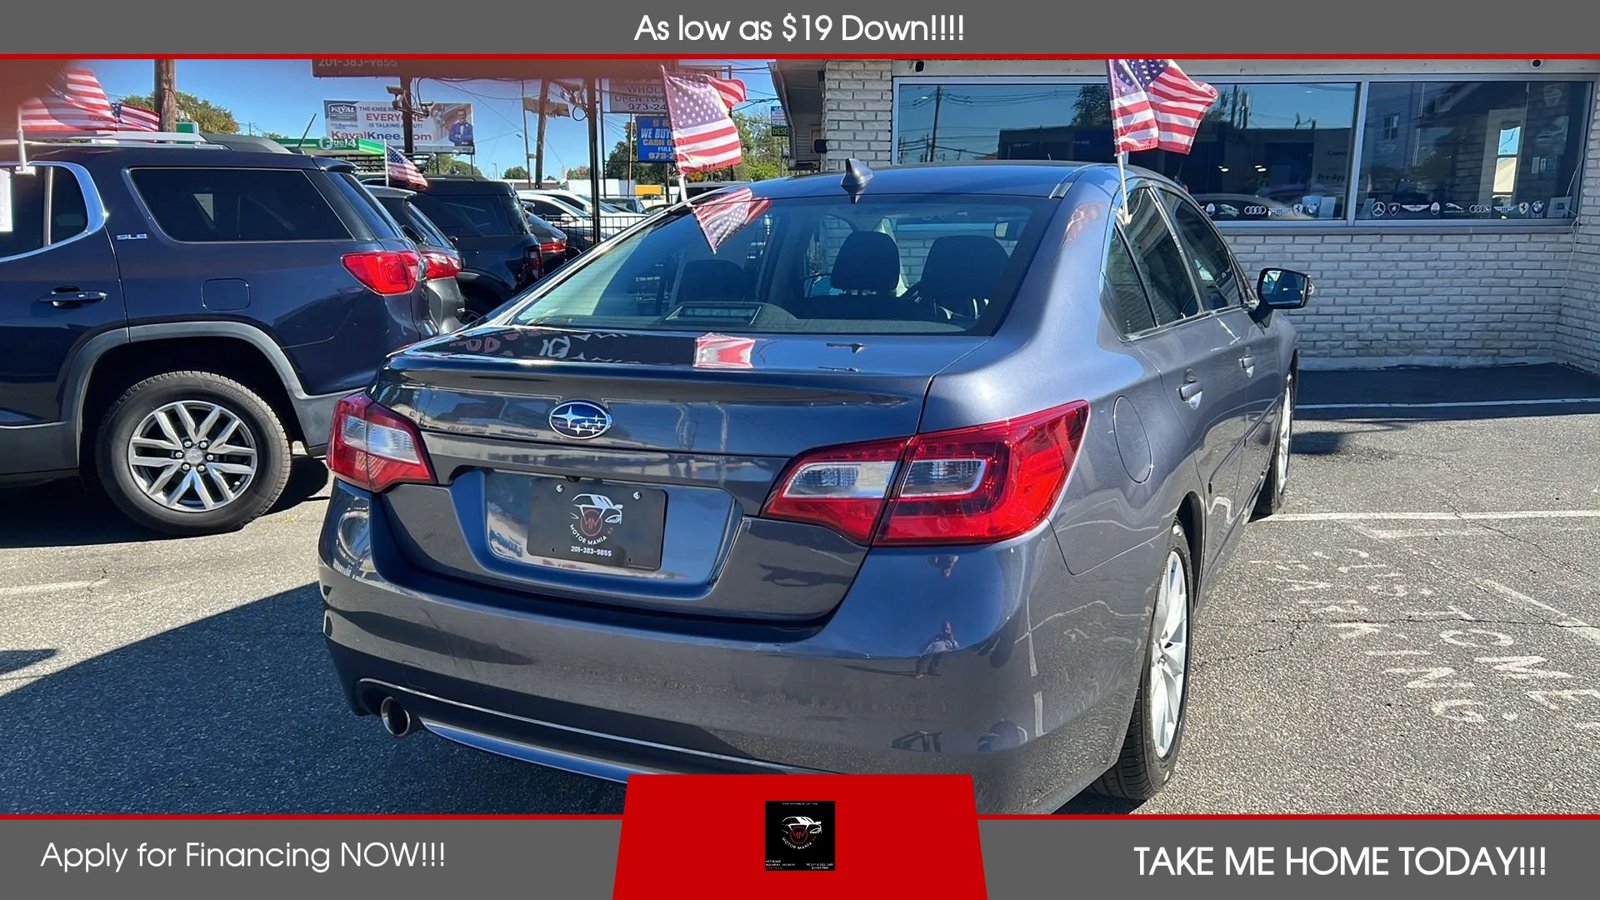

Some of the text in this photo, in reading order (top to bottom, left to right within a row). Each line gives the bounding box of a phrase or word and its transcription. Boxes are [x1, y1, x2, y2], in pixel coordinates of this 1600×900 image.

[366, 113, 424, 122] EVERYNE
[331, 130, 432, 141] KayalKnee.om
[641, 128, 672, 138] WE BUY
[569, 524, 607, 545] MOTOR MANIA
[570, 545, 612, 557] 201-383-9855
